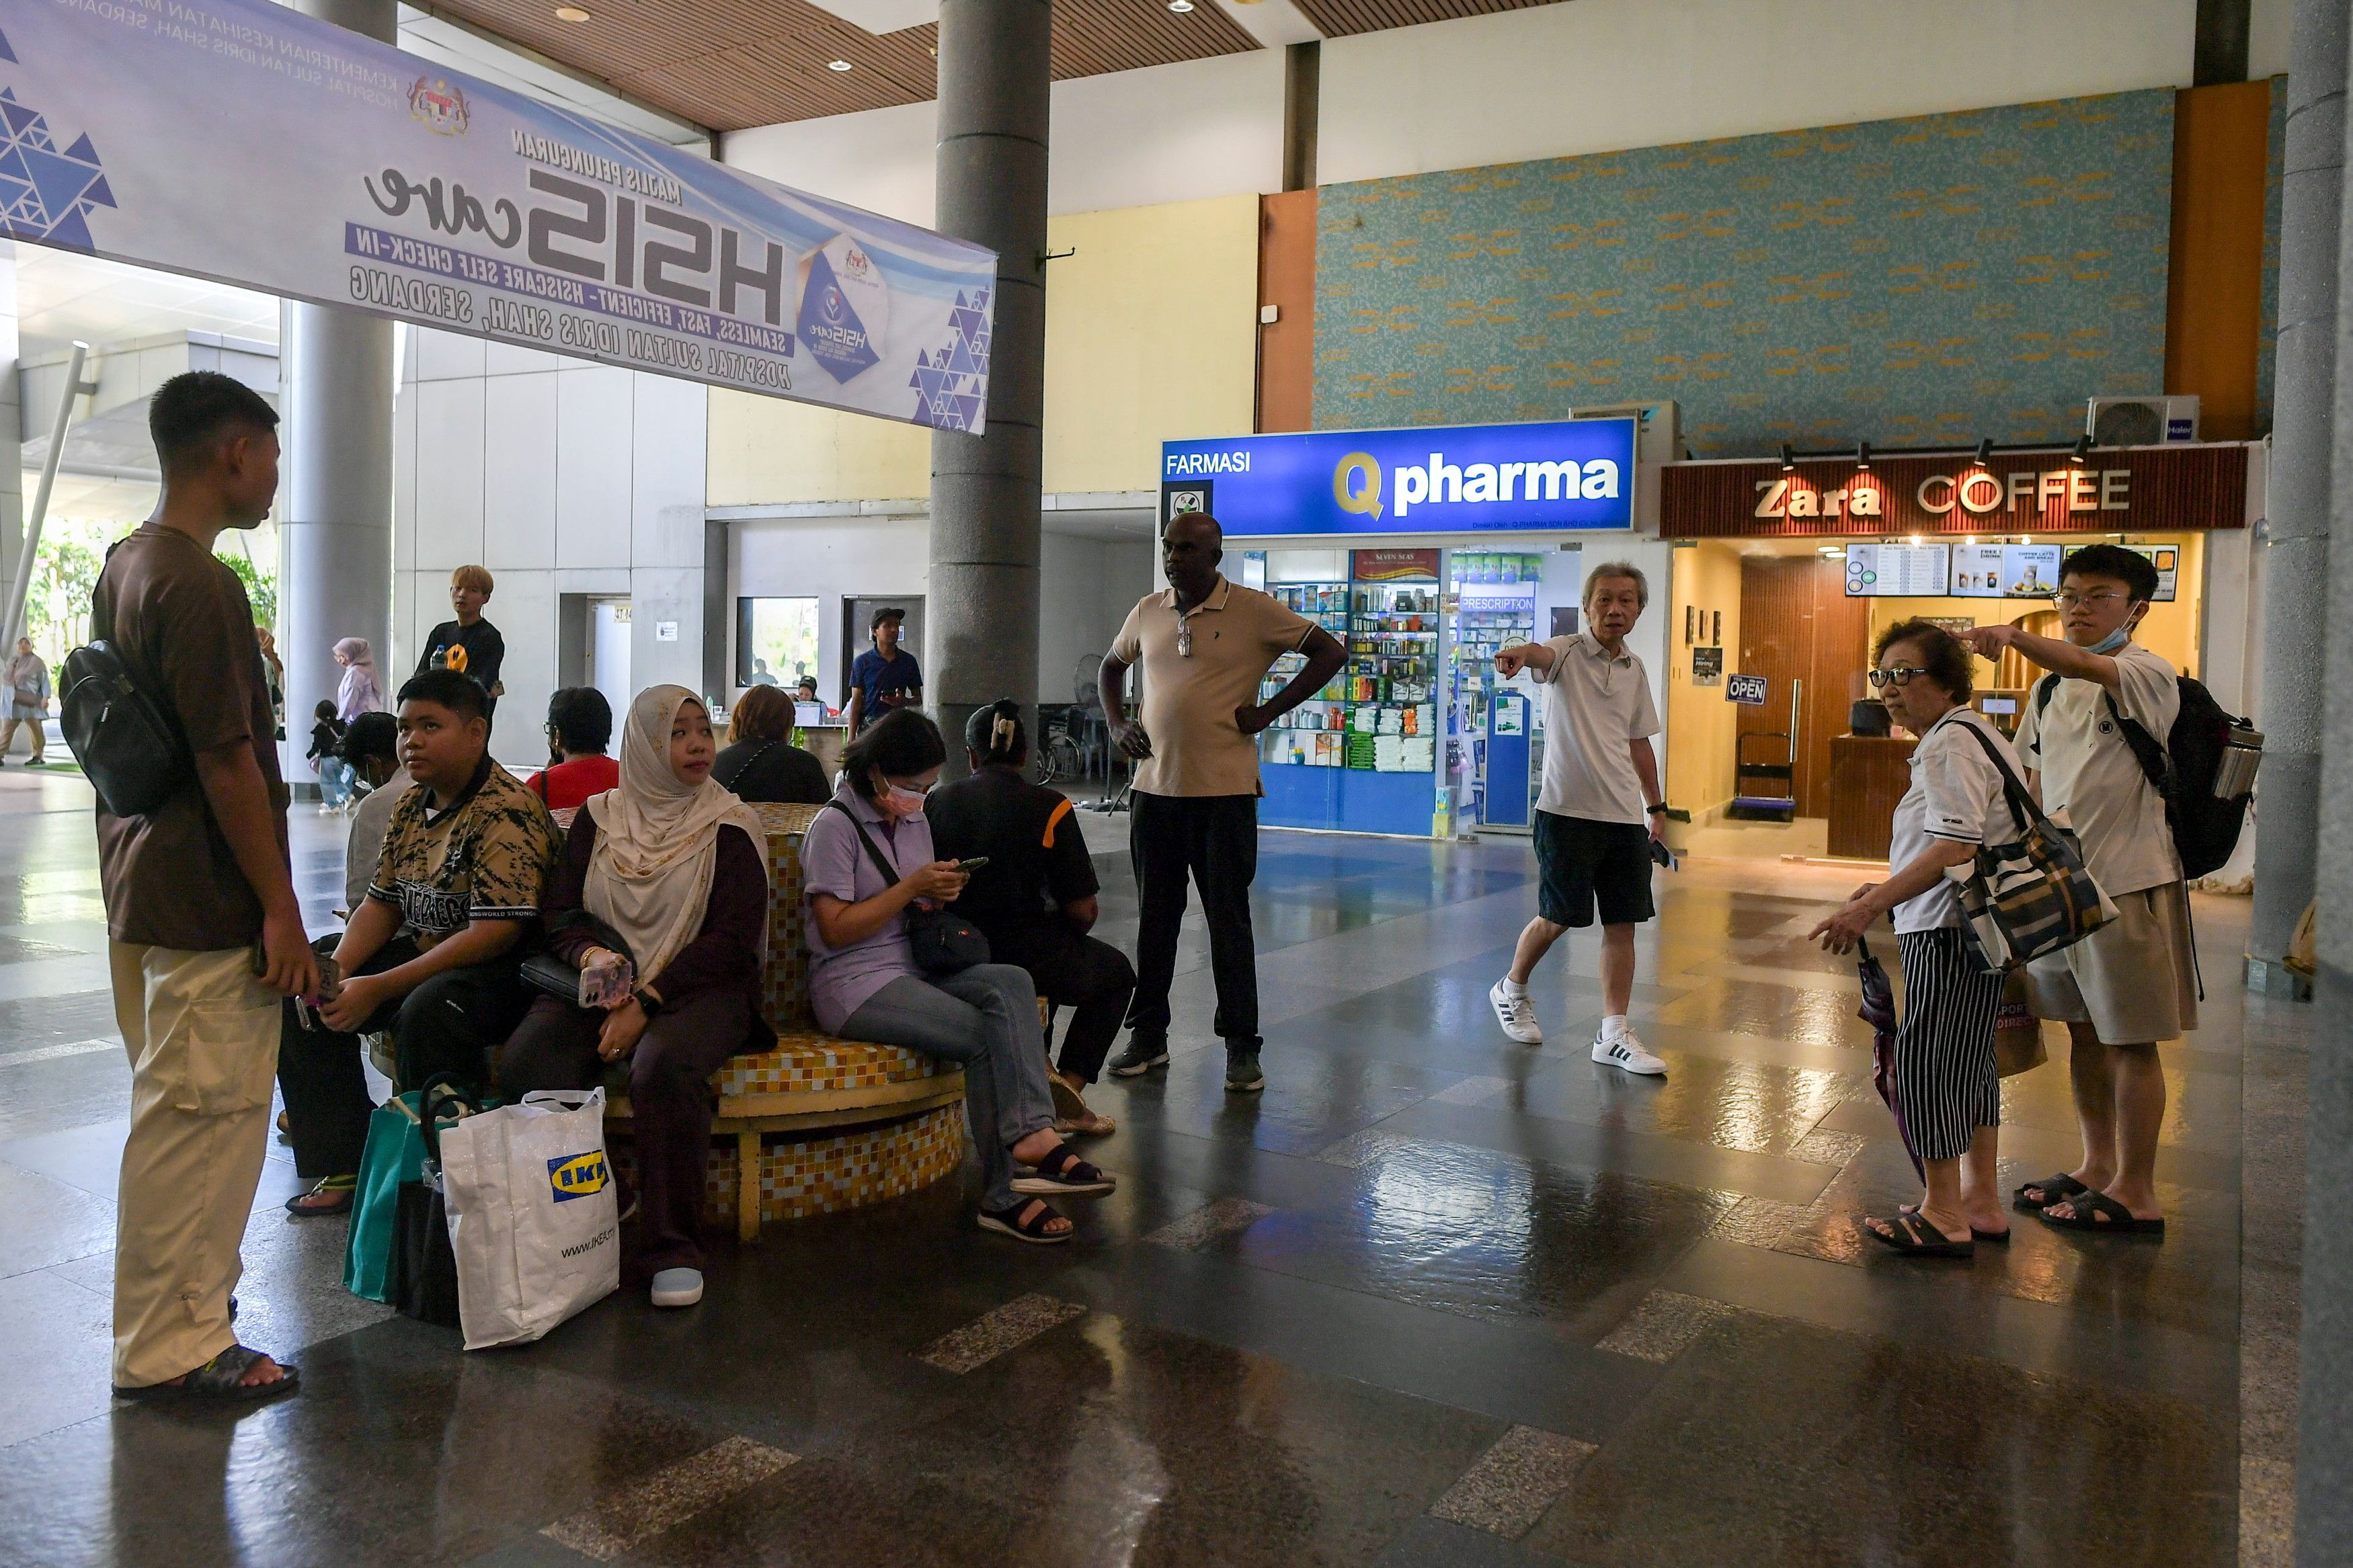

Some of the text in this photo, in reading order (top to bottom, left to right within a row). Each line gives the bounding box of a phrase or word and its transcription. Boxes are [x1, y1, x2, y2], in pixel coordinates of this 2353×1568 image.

[2168, 425, 2191, 434] Haier
[1166, 451, 1250, 475] FARMASI
[1333, 452, 1620, 522] Q pharma
[1755, 470, 2131, 518] Zara COFFEE
[1730, 681, 1763, 699] OPEN
